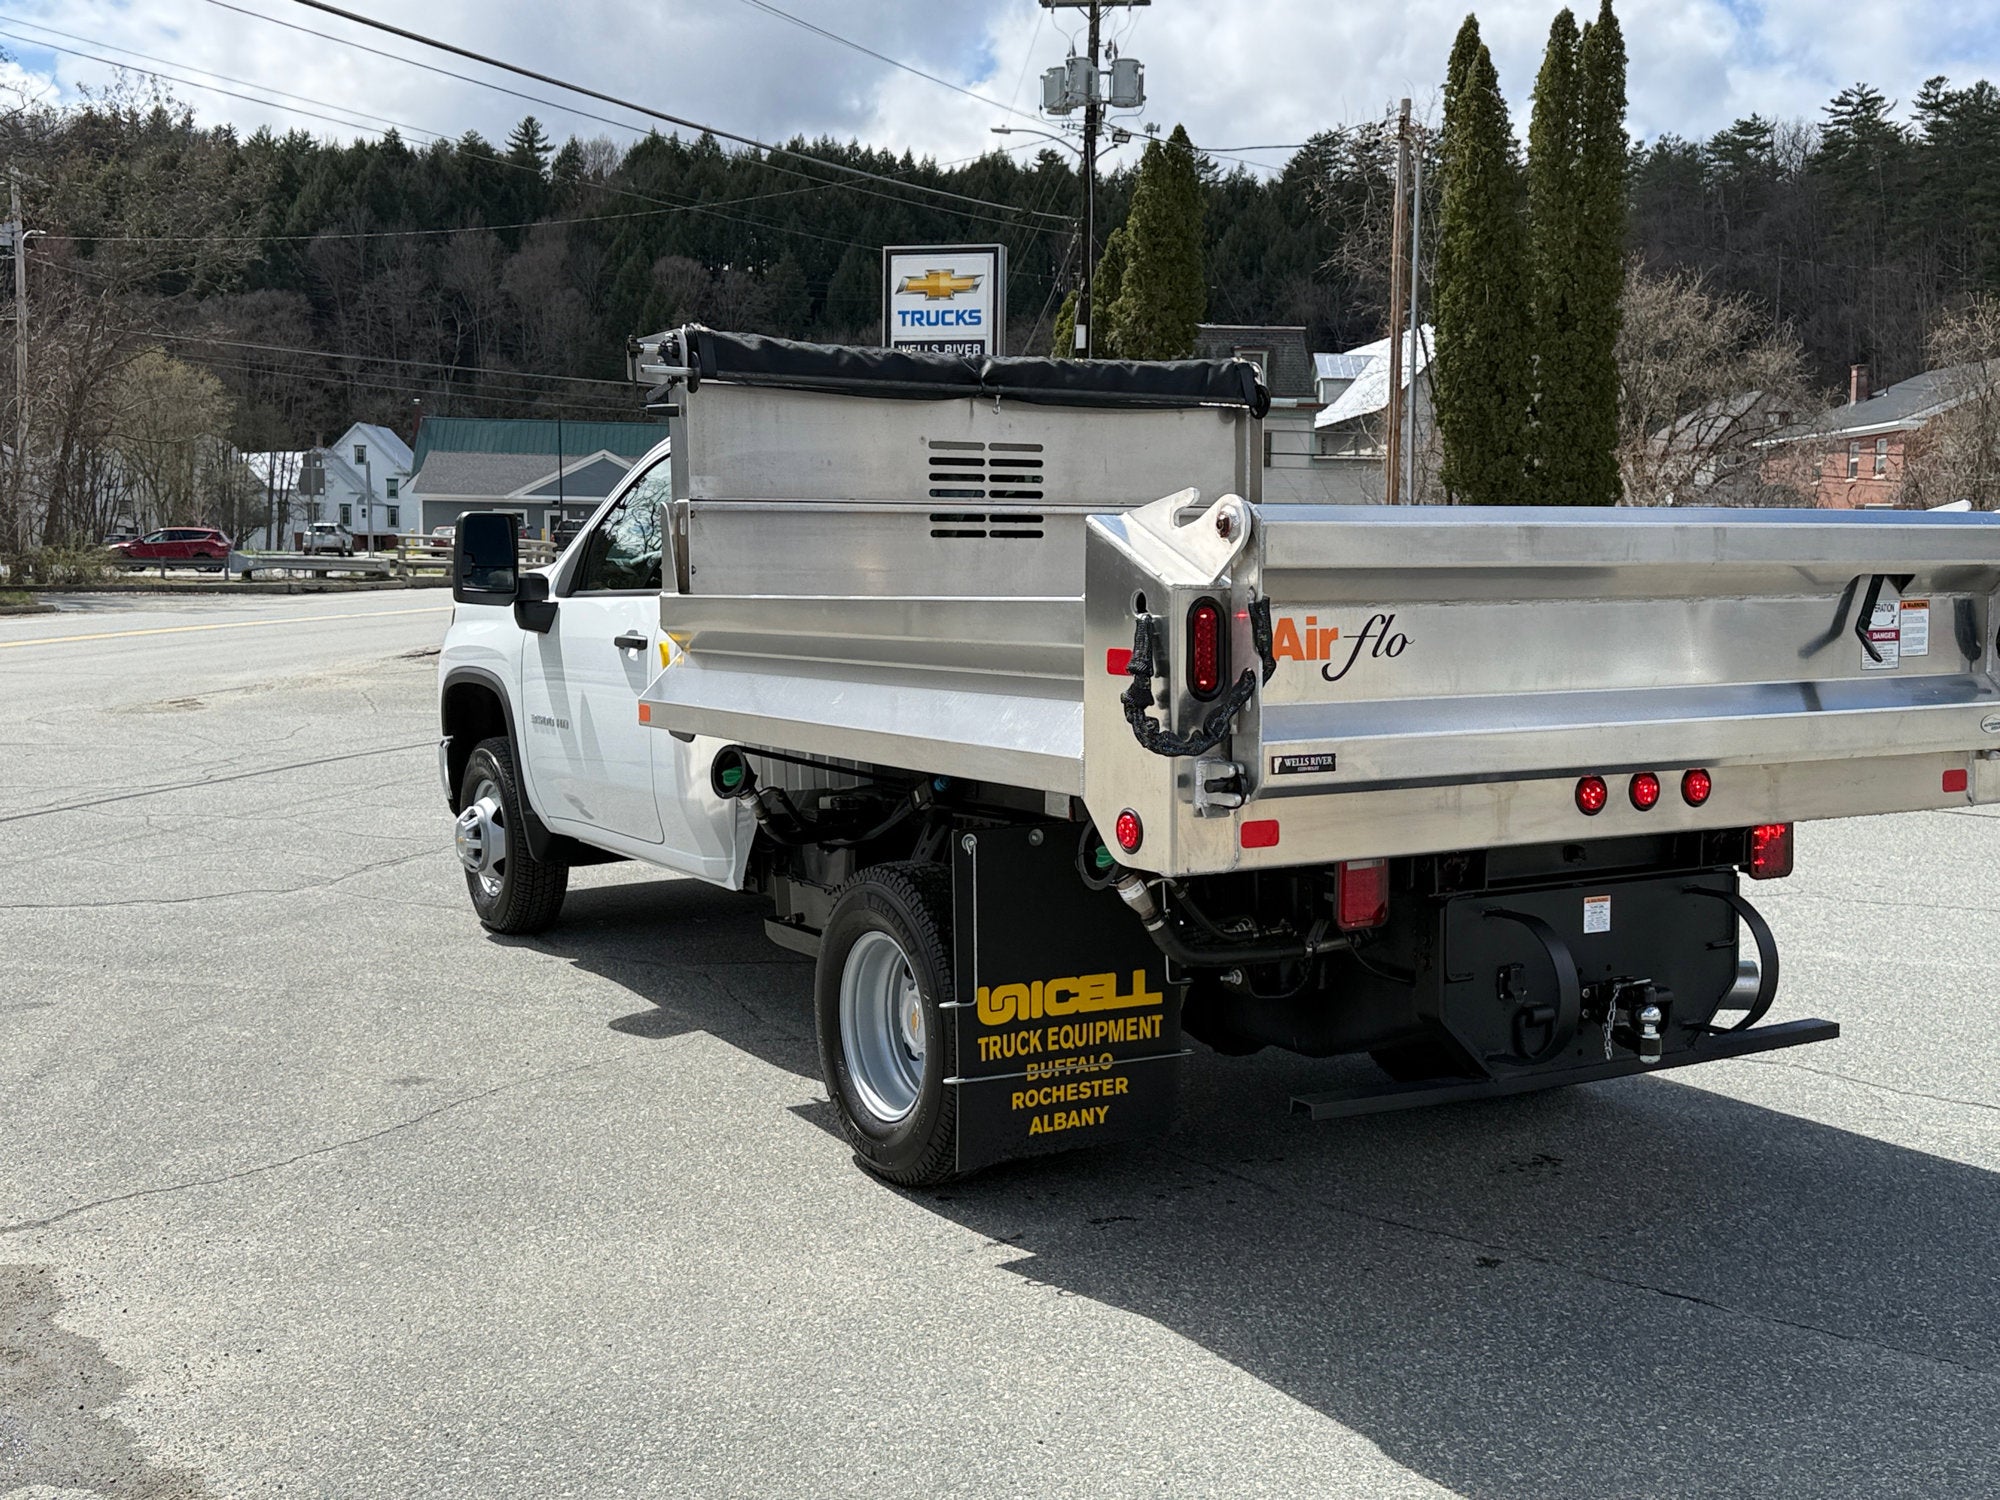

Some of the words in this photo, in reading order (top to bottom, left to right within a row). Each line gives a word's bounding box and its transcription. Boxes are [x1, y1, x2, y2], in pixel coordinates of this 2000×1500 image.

[897, 309, 982, 327] TRUCKS
[944, 343, 981, 355] RIVER
[1272, 615, 1339, 661] Air
[1872, 631, 1896, 640] DANGER
[1284, 757, 1310, 767] WELLS
[1310, 755, 1333, 766] RIVER
[977, 969, 1163, 1026] UNICELL
[978, 1029, 1043, 1062] TRUCK
[1047, 1014, 1164, 1050] EQUIPMENT
[1026, 1052, 1114, 1081] BUFFALO
[1011, 1077, 1129, 1110] ROCHESTER
[1029, 1105, 1110, 1136] ALBANY
